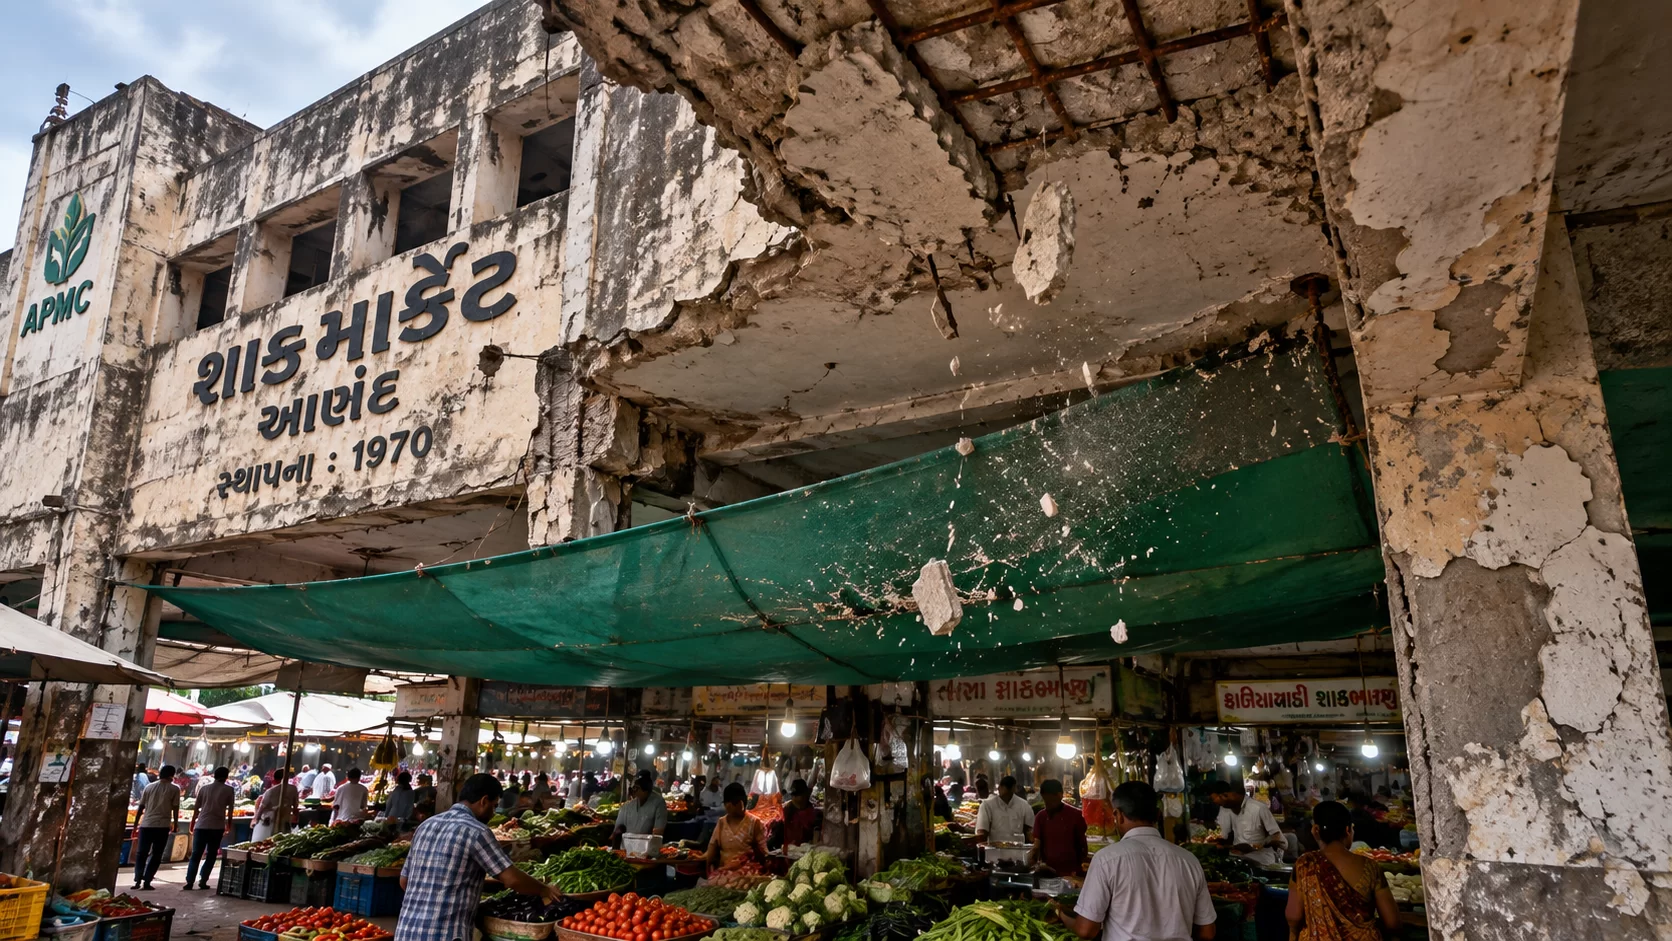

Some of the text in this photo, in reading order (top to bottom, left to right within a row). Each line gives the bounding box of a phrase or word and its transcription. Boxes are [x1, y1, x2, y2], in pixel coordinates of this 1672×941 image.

[20, 279, 94, 338] APMC
[193, 241, 517, 405] શાક માર્કેટ
[257, 364, 400, 440] આણંદ
[216, 453, 315, 499] સ્થાપના
[352, 425, 433, 472] 1970
